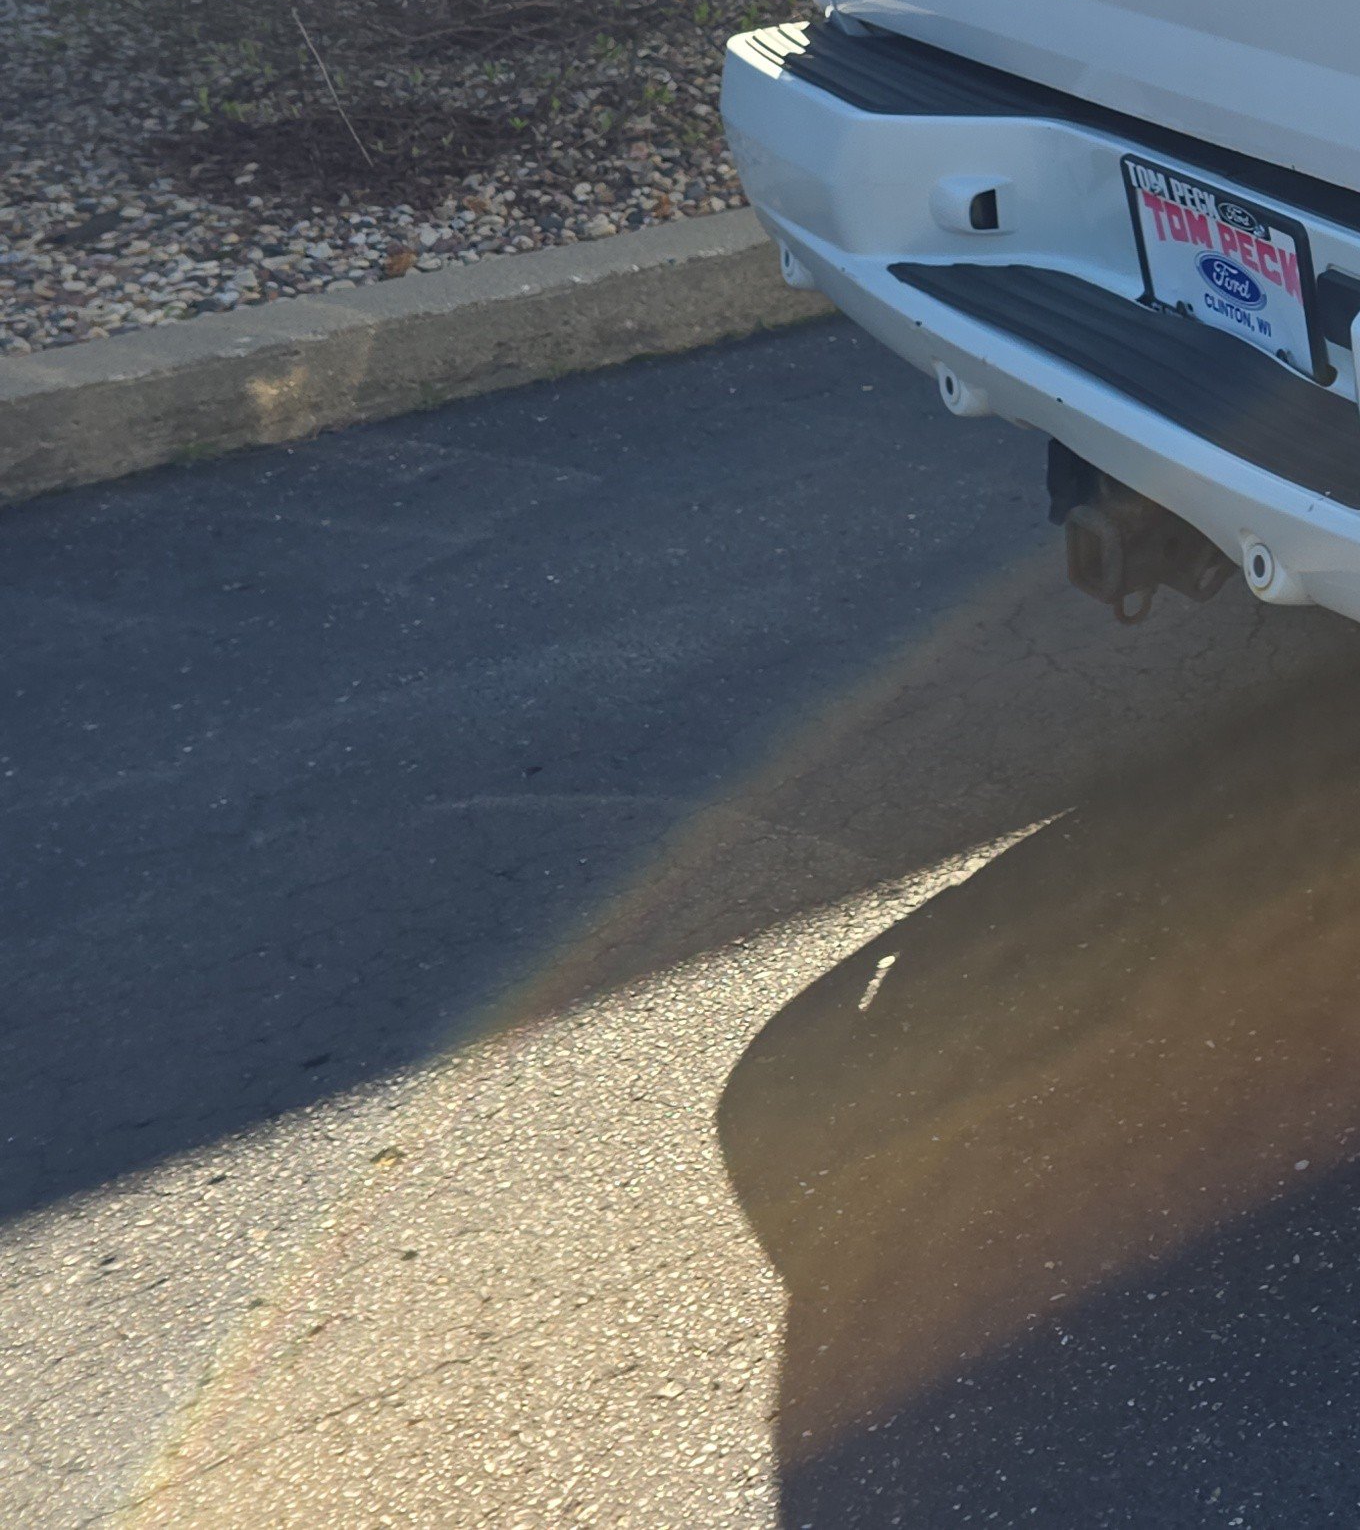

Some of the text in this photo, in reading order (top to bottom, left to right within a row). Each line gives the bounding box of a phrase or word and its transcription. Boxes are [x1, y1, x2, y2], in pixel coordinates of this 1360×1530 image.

[1124, 160, 1169, 200] TOM
[1169, 177, 1220, 221] PECK
[1142, 190, 1213, 250] TOM
[1212, 260, 1252, 299] Ford
[1204, 293, 1256, 332] CLINTON,
[1257, 320, 1272, 338] WI
